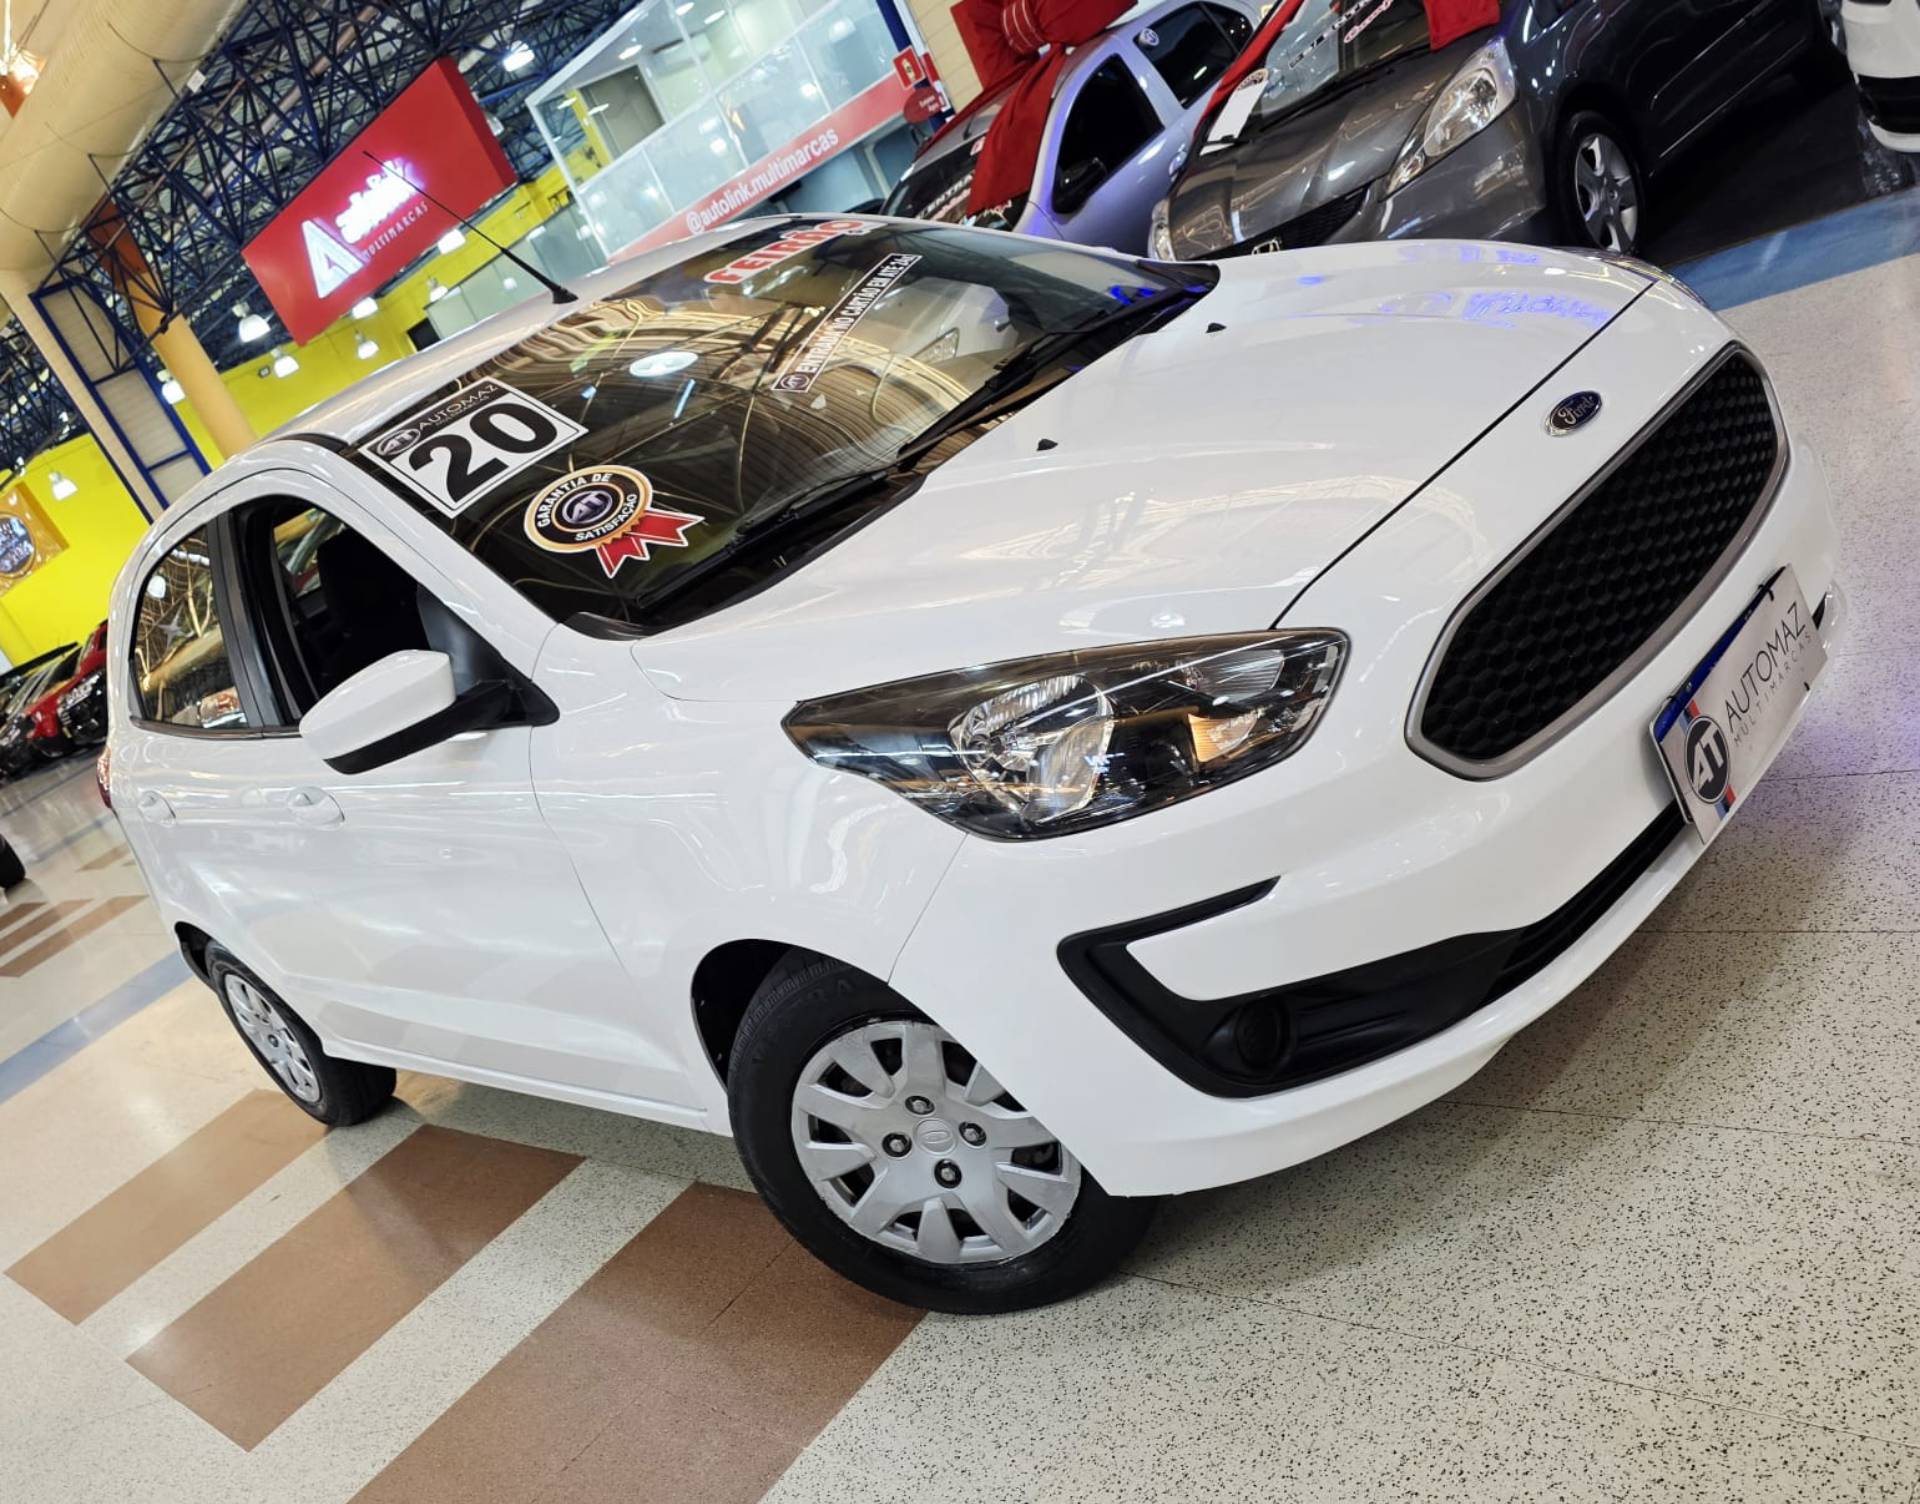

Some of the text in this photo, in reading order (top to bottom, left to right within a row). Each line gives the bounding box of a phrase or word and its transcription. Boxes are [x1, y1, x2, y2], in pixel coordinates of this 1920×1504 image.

[686, 128, 839, 235] @autolink.multimarcas
[706, 220, 865, 284] FEIRÃO
[878, 264, 904, 278] ATÉ
[840, 287, 882, 316] CARTÃO
[867, 277, 892, 288] EM
[832, 317, 855, 329] NO
[796, 331, 846, 373] ENTRADA
[418, 384, 499, 431] AUTOMAZ
[1557, 396, 1595, 425] Ford
[408, 402, 558, 503] 20
[537, 472, 614, 527] GARANTIA DE
[575, 493, 638, 541] SATISFAÇÃO
[1723, 600, 1807, 733] AUTOMAZ
[1733, 630, 1814, 747] MULTIMARCAS
